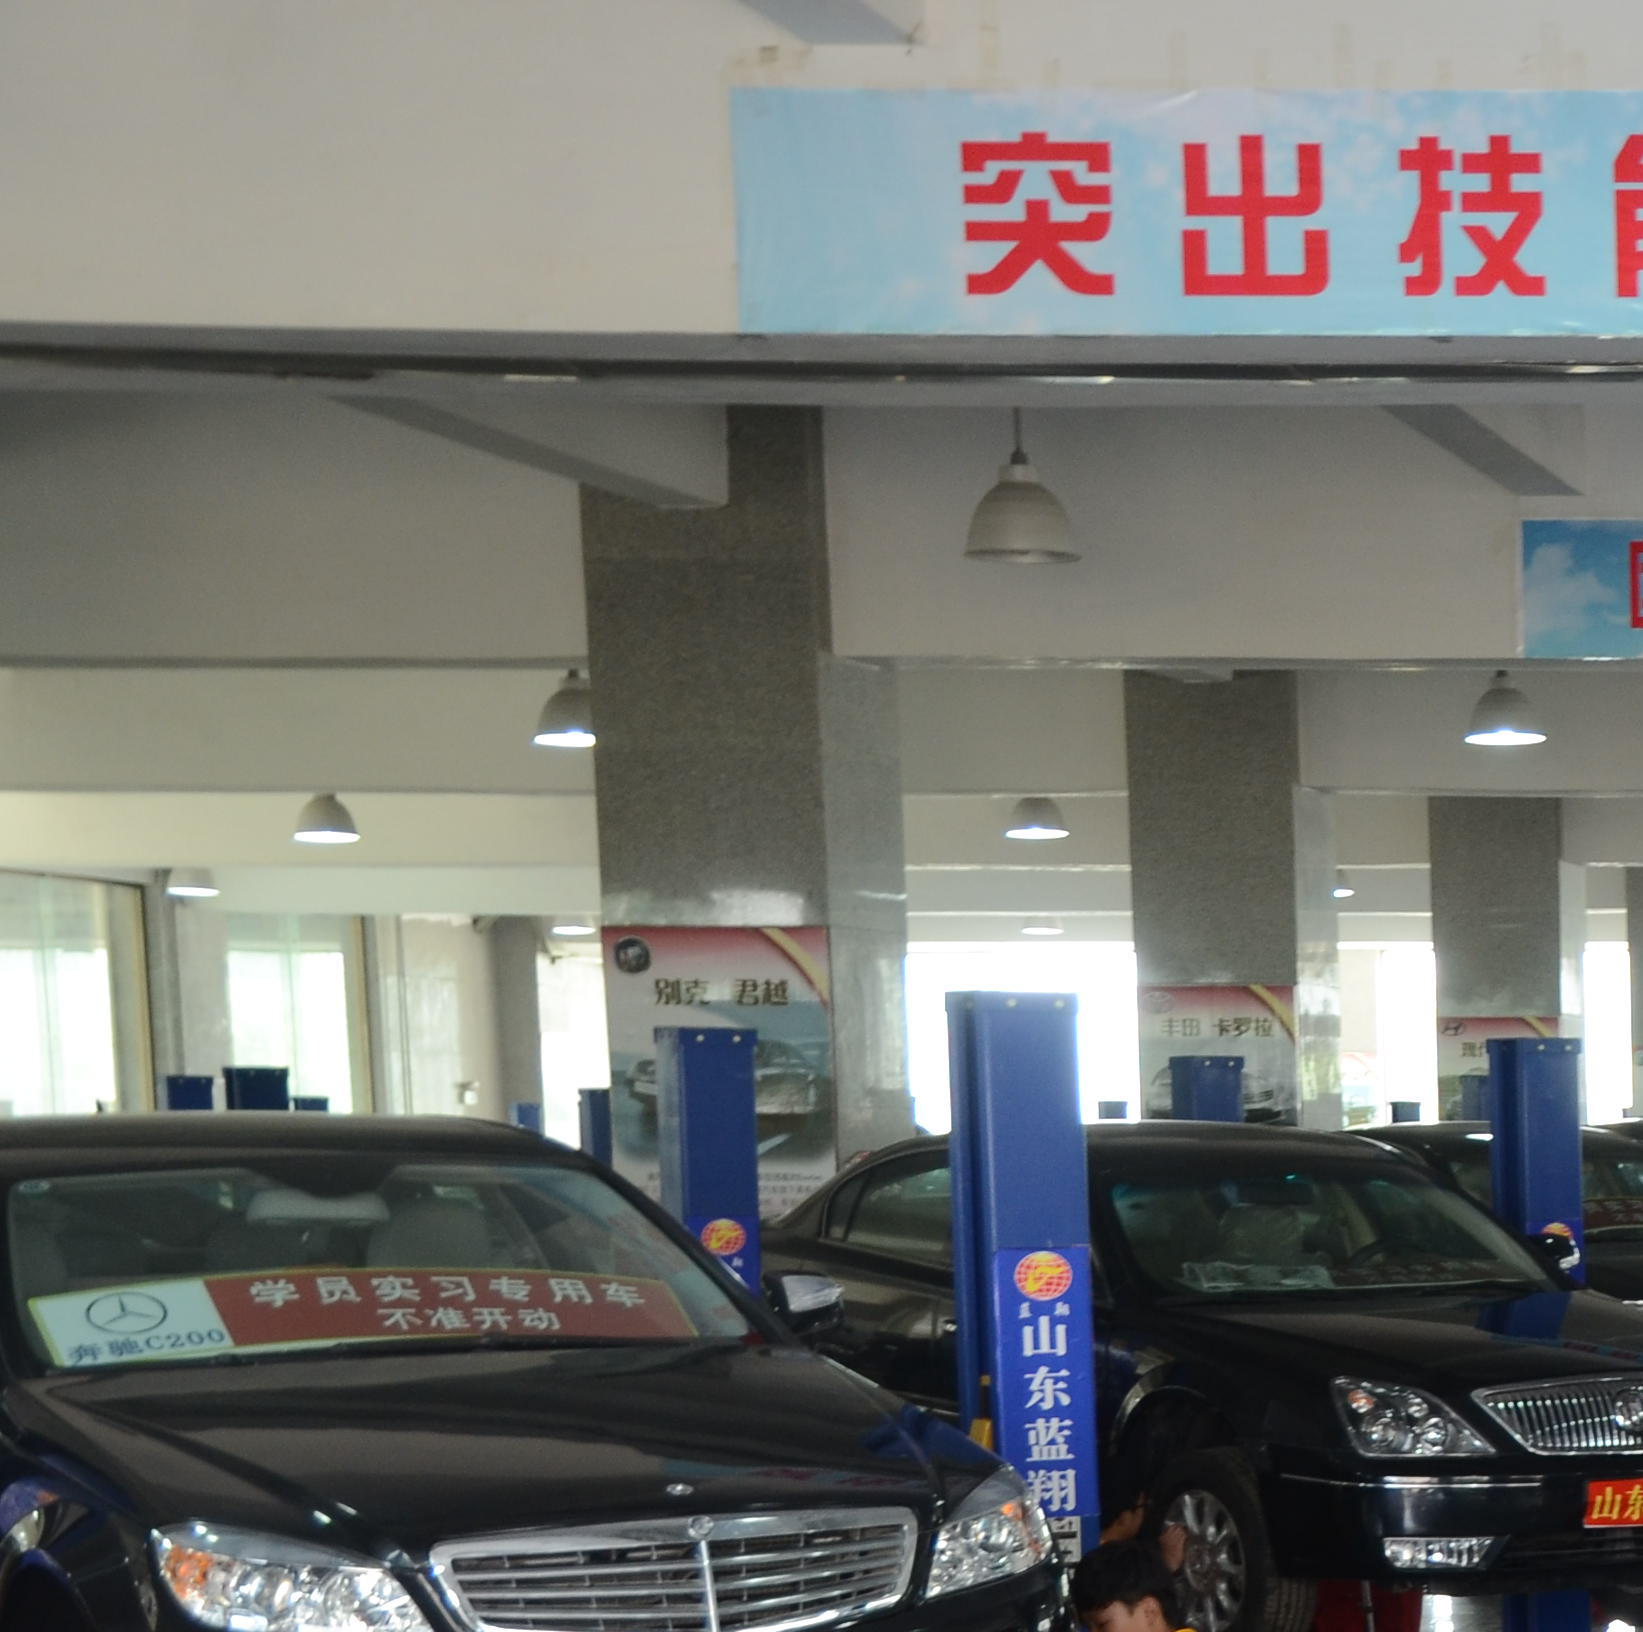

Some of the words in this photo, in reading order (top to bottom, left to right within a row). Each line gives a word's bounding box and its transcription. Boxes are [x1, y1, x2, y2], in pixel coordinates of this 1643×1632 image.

[654, 977, 711, 1006] 别克
[734, 977, 790, 1006] 君越
[1161, 1016, 1200, 1037] 丰田
[1211, 1016, 1275, 1038] 卡罗拉
[249, 1276, 647, 1309] 学员实习专用车
[382, 1306, 562, 1332] 不准开动
[1022, 1314, 1077, 1513] 山东蓝翔
